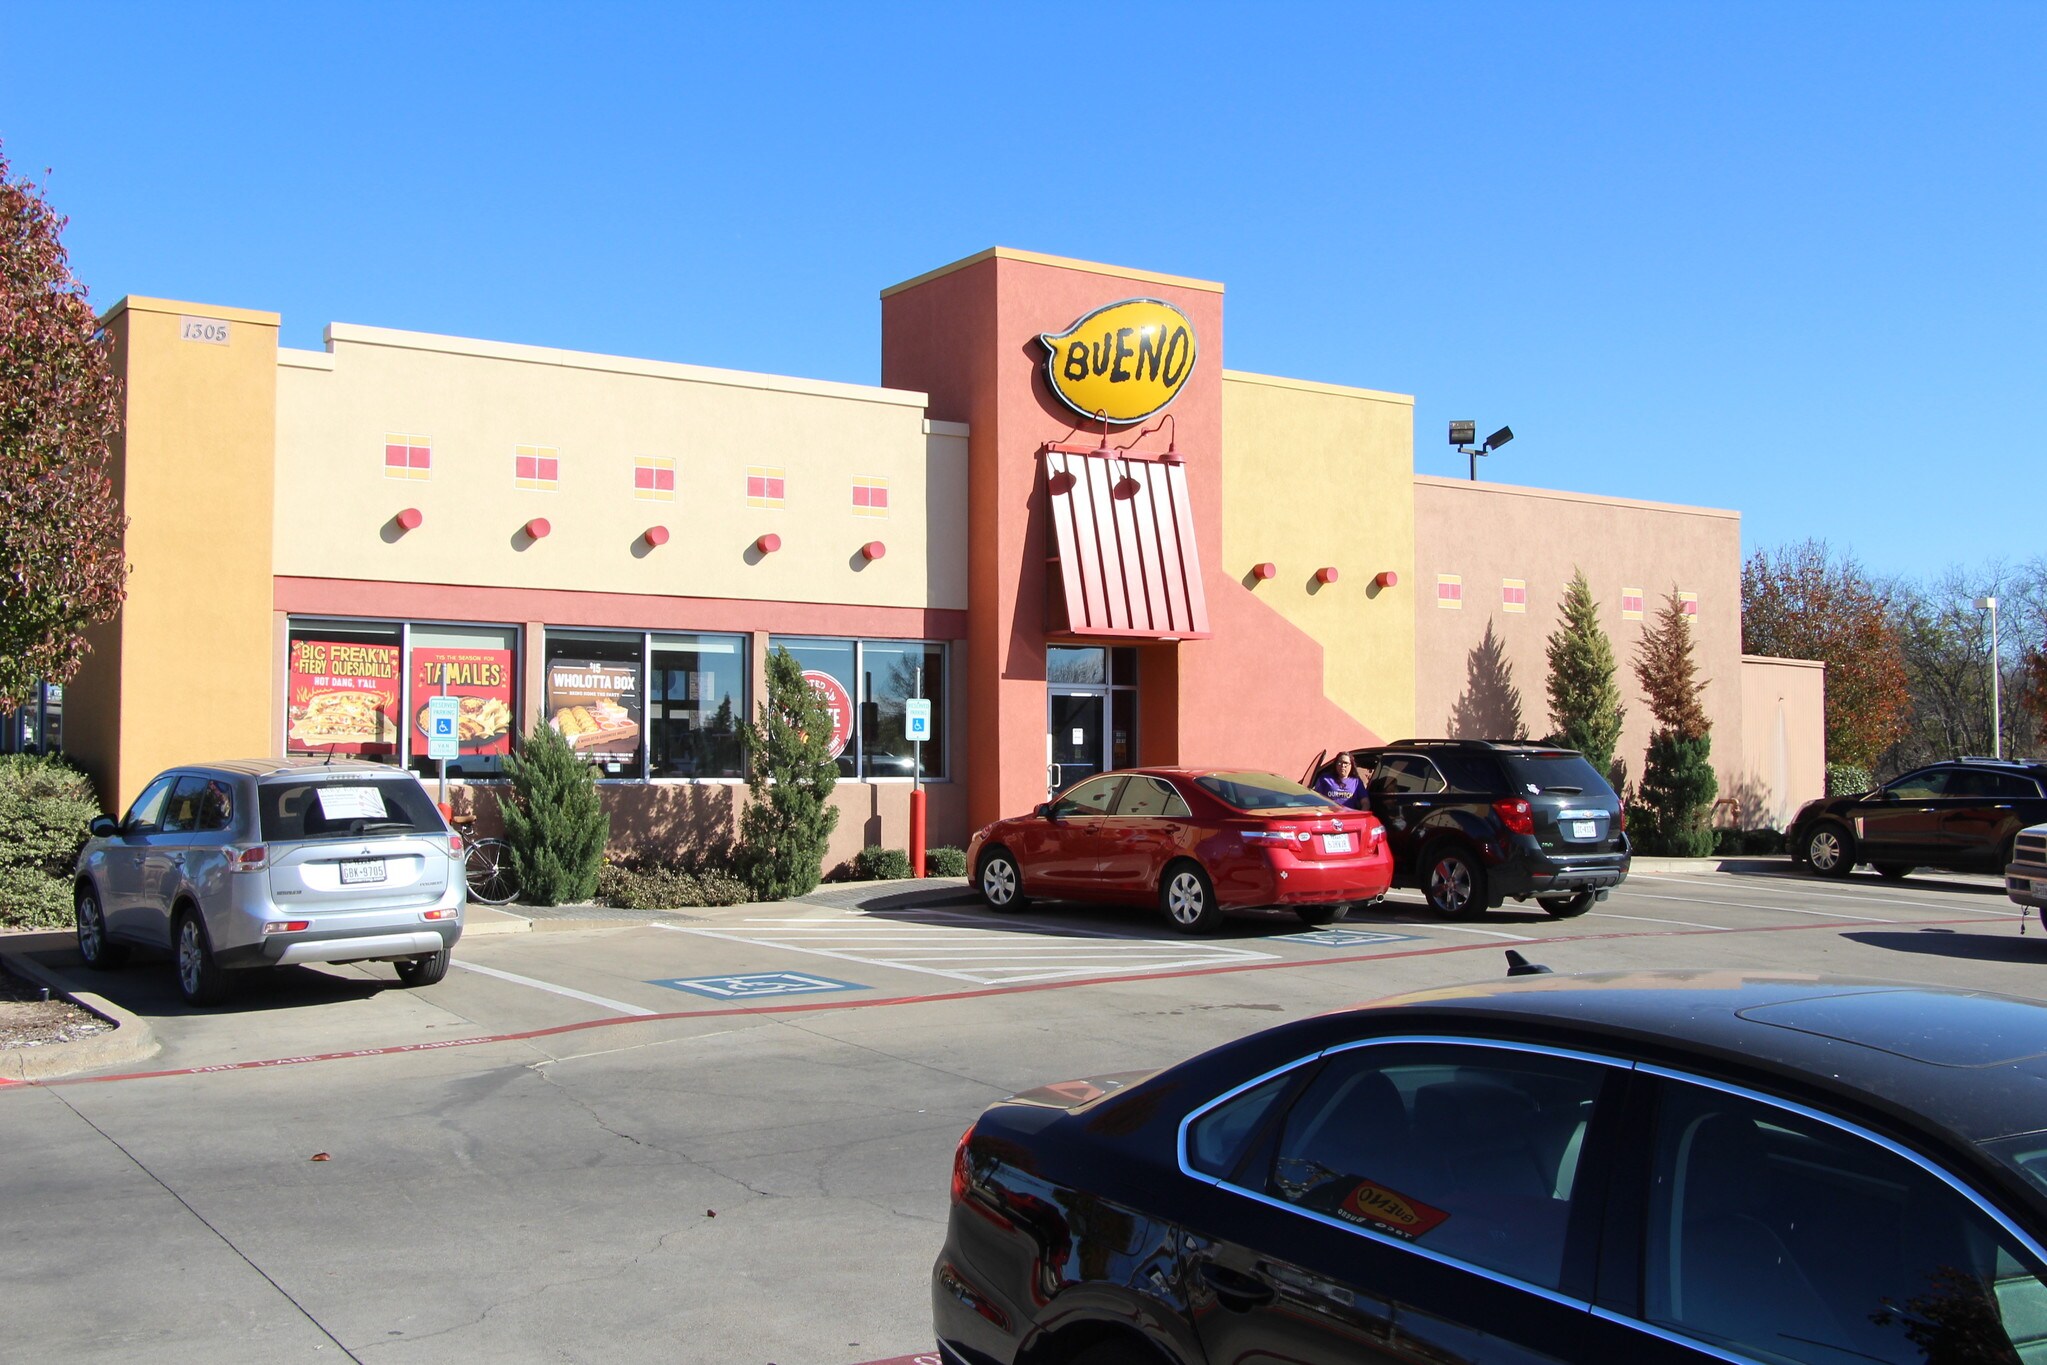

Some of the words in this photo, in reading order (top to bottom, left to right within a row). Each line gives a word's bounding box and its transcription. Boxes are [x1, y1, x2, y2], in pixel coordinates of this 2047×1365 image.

[183, 323, 227, 341] 1305
[1063, 324, 1189, 389] BUENO
[301, 644, 326, 660] BIG
[330, 645, 389, 664] FREAK'N
[299, 659, 327, 675] FIERY
[331, 660, 392, 678] QUESADILLA
[424, 662, 500, 686] TAMALES
[589, 662, 602, 674] $15
[314, 677, 329, 686] HOT
[357, 679, 377, 689] Y'ALL
[553, 673, 612, 690] WHOLOTTA
[613, 675, 635, 691] BOX
[190, 1064, 243, 1074] FIRE
[258, 1055, 320, 1066] LANE
[352, 1048, 384, 1056] NO
[401, 1037, 492, 1051] PARKING
